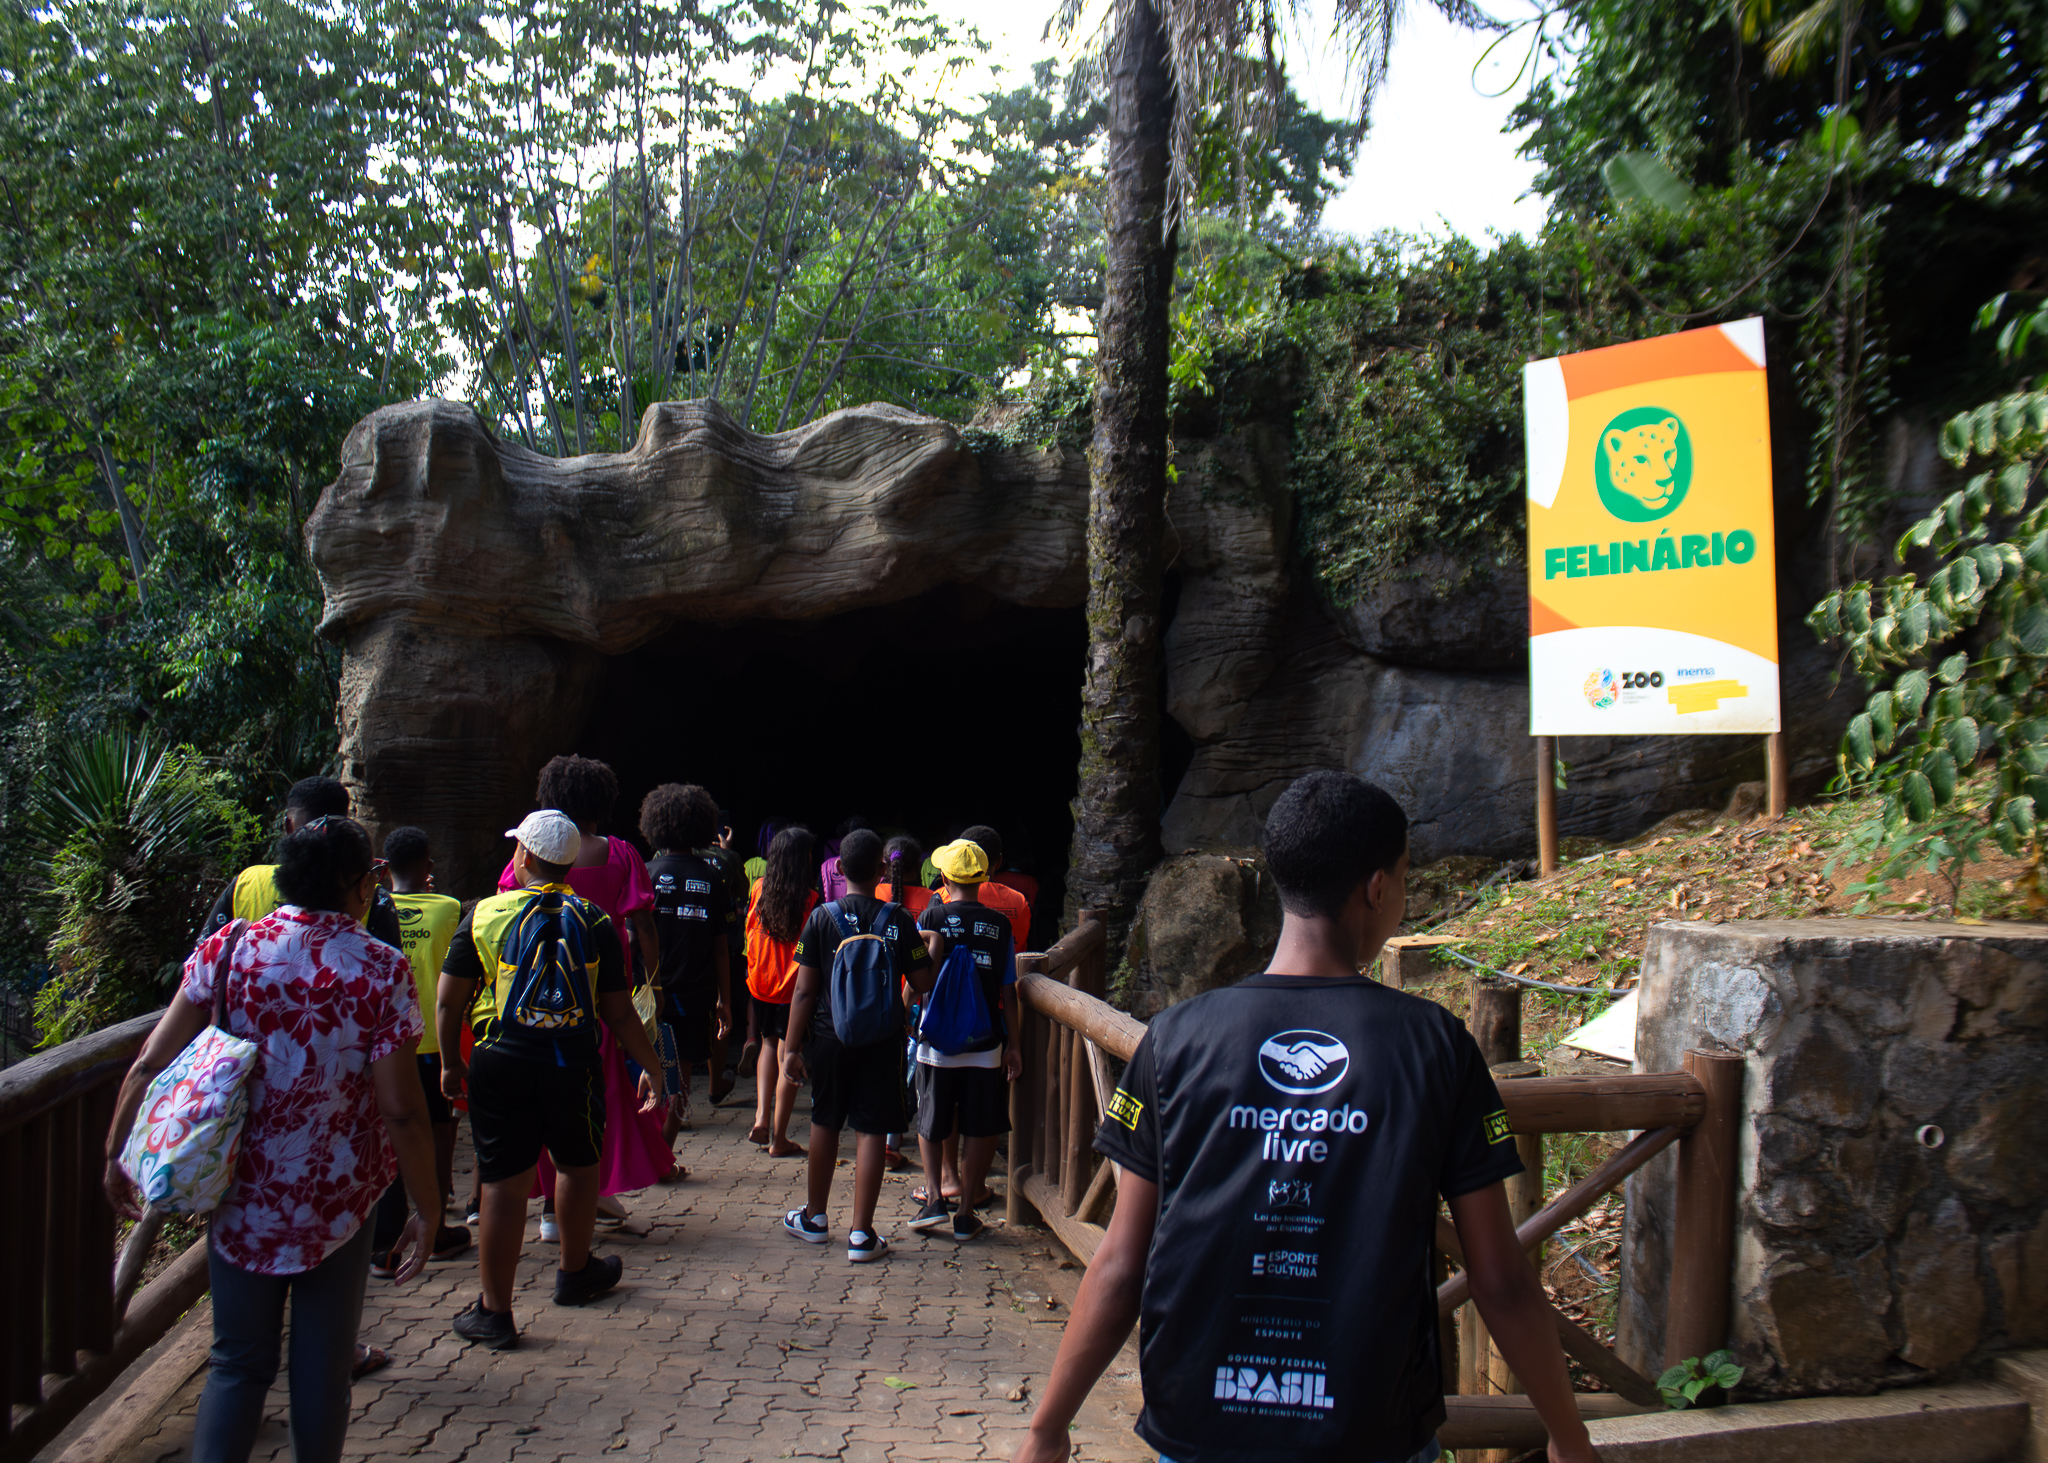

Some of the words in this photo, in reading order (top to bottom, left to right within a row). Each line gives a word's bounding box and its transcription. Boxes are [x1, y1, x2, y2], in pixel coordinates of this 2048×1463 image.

[1545, 528, 1756, 580] FELINÁRIO
[1677, 666, 1715, 677] inema
[1621, 670, 1666, 689] ZOO
[677, 906, 708, 919] BRASIL
[400, 928, 431, 939] cado
[1230, 1103, 1368, 1134] mercado
[1263, 1131, 1328, 1163] livre
[1254, 1212, 1269, 1222] Lei
[1271, 1214, 1282, 1222] de
[1284, 1214, 1325, 1225] Incentivo
[1266, 1224, 1278, 1232] ao
[1269, 1250, 1318, 1265] ESPORTE
[1267, 1263, 1317, 1278] CULTURA
[1305, 1319, 1320, 1329] DO
[1255, 1328, 1302, 1340] ESPORTE
[1227, 1353, 1277, 1366] GOVERNO
[1281, 1357, 1327, 1370] FEDERAL
[1214, 1366, 1334, 1409] BRASIL
